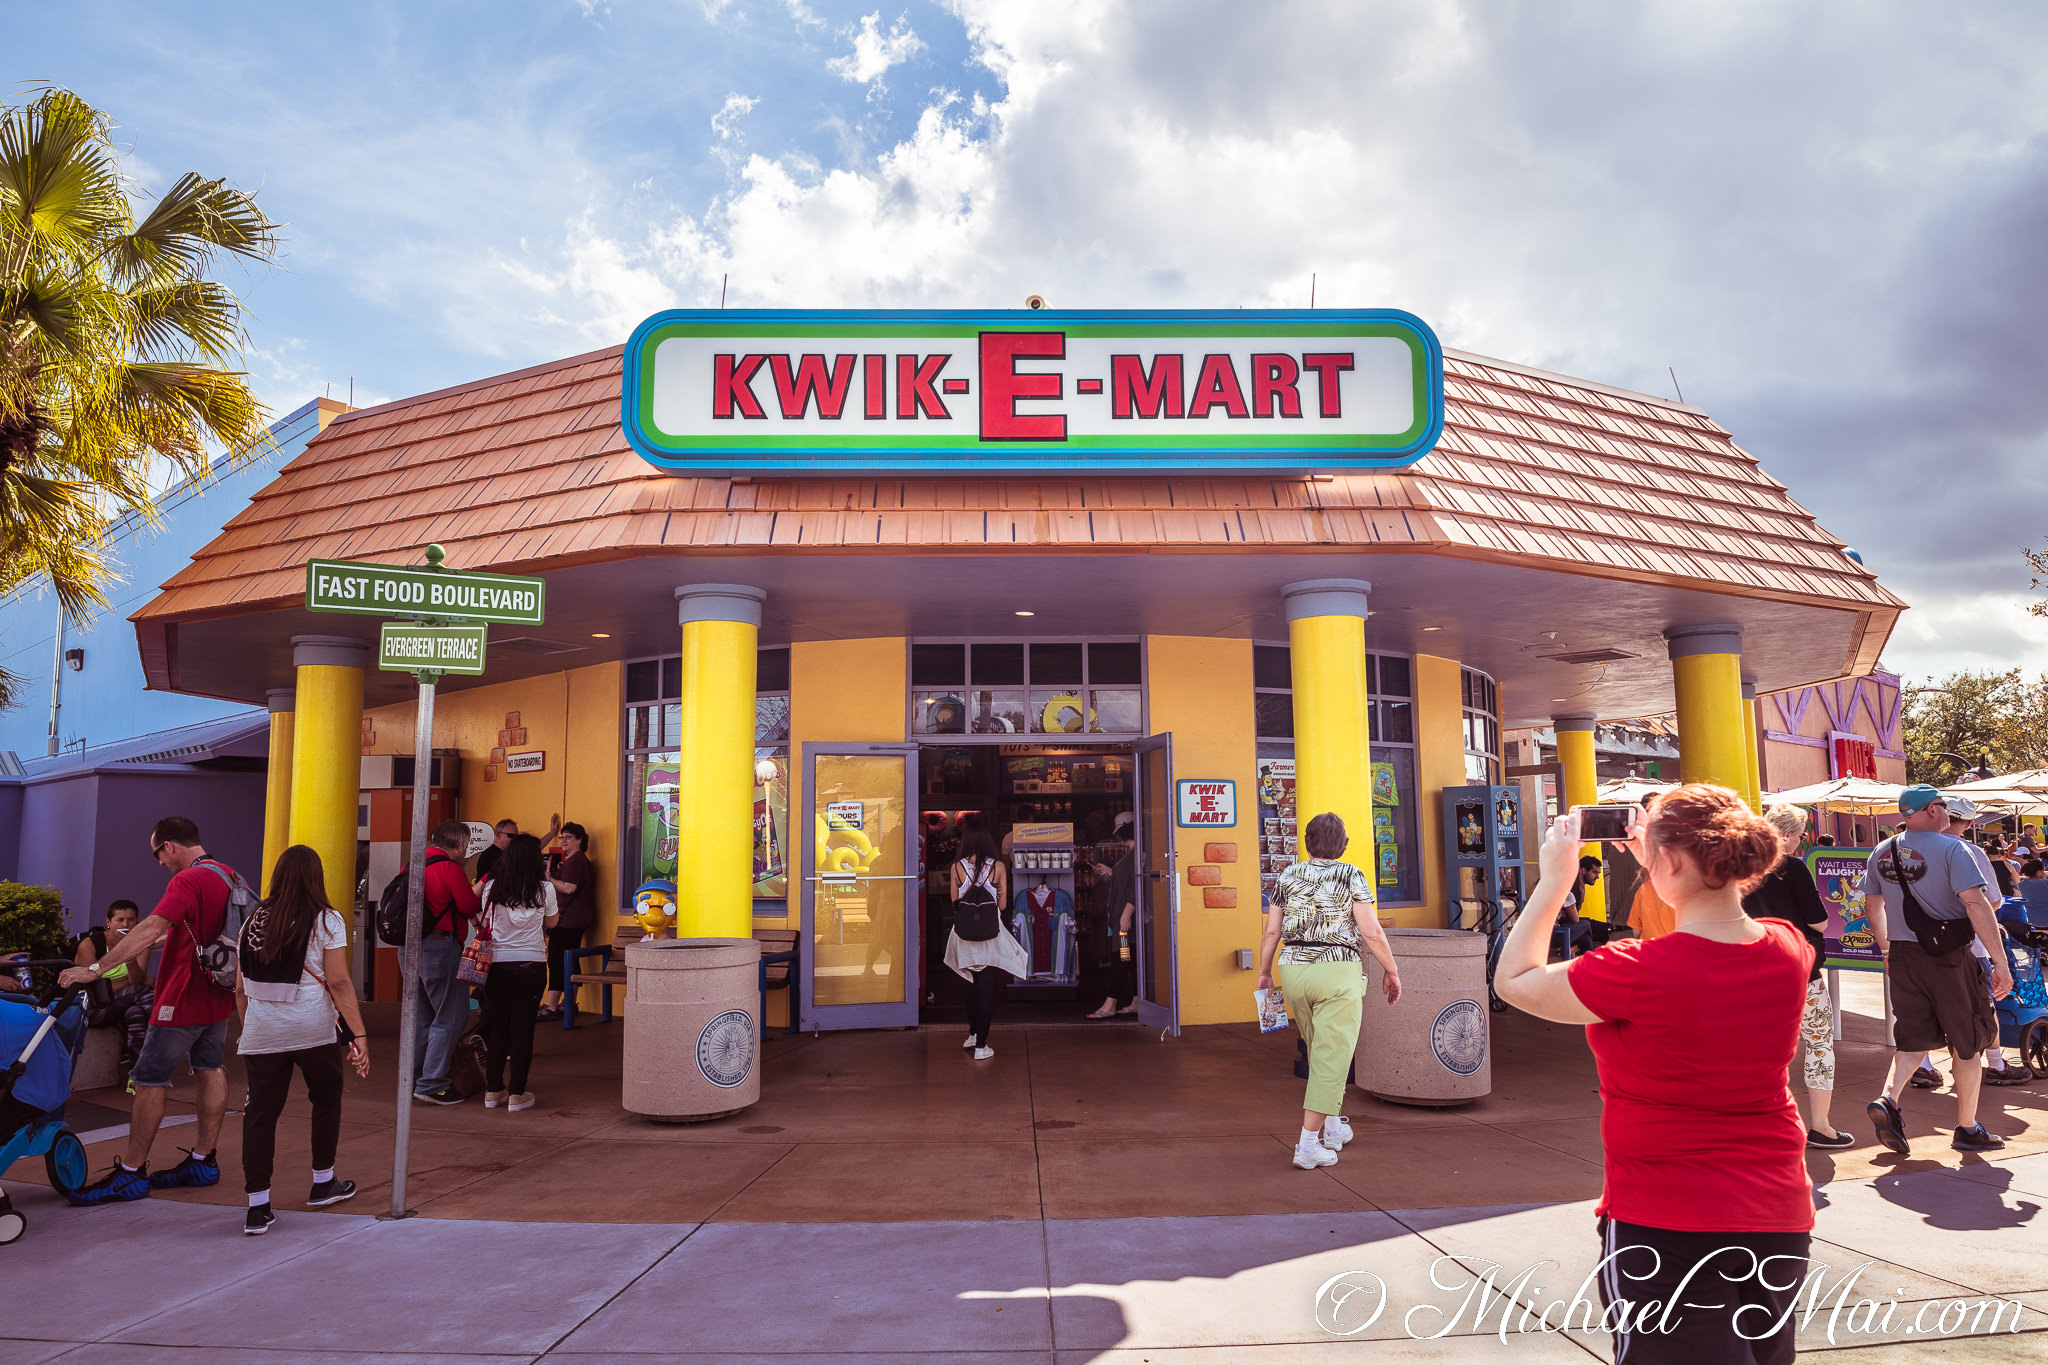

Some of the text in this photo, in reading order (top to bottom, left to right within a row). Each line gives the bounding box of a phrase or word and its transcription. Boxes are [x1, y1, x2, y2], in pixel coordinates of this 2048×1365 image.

[318, 574, 536, 612] FAST FOOD BOULEVARD
[385, 636, 479, 660] EVERGREEN TERRACE
[508, 757, 543, 769] NO SKATEBOARDING
[1270, 761, 1294, 771] Farmer
[1189, 784, 1227, 795] KWIK
[831, 812, 858, 820] HOURS
[1189, 812, 1228, 823] MART
[471, 826, 483, 834] the
[470, 846, 484, 854] you
[1818, 868, 1856, 876] LAUGH
[1842, 935, 1873, 946] EXPRESS
[743, 1021, 751, 1032] USA
[1440, 1051, 1476, 1071] ESTABLISHED
[705, 1064, 742, 1082] ESTABLISHED
